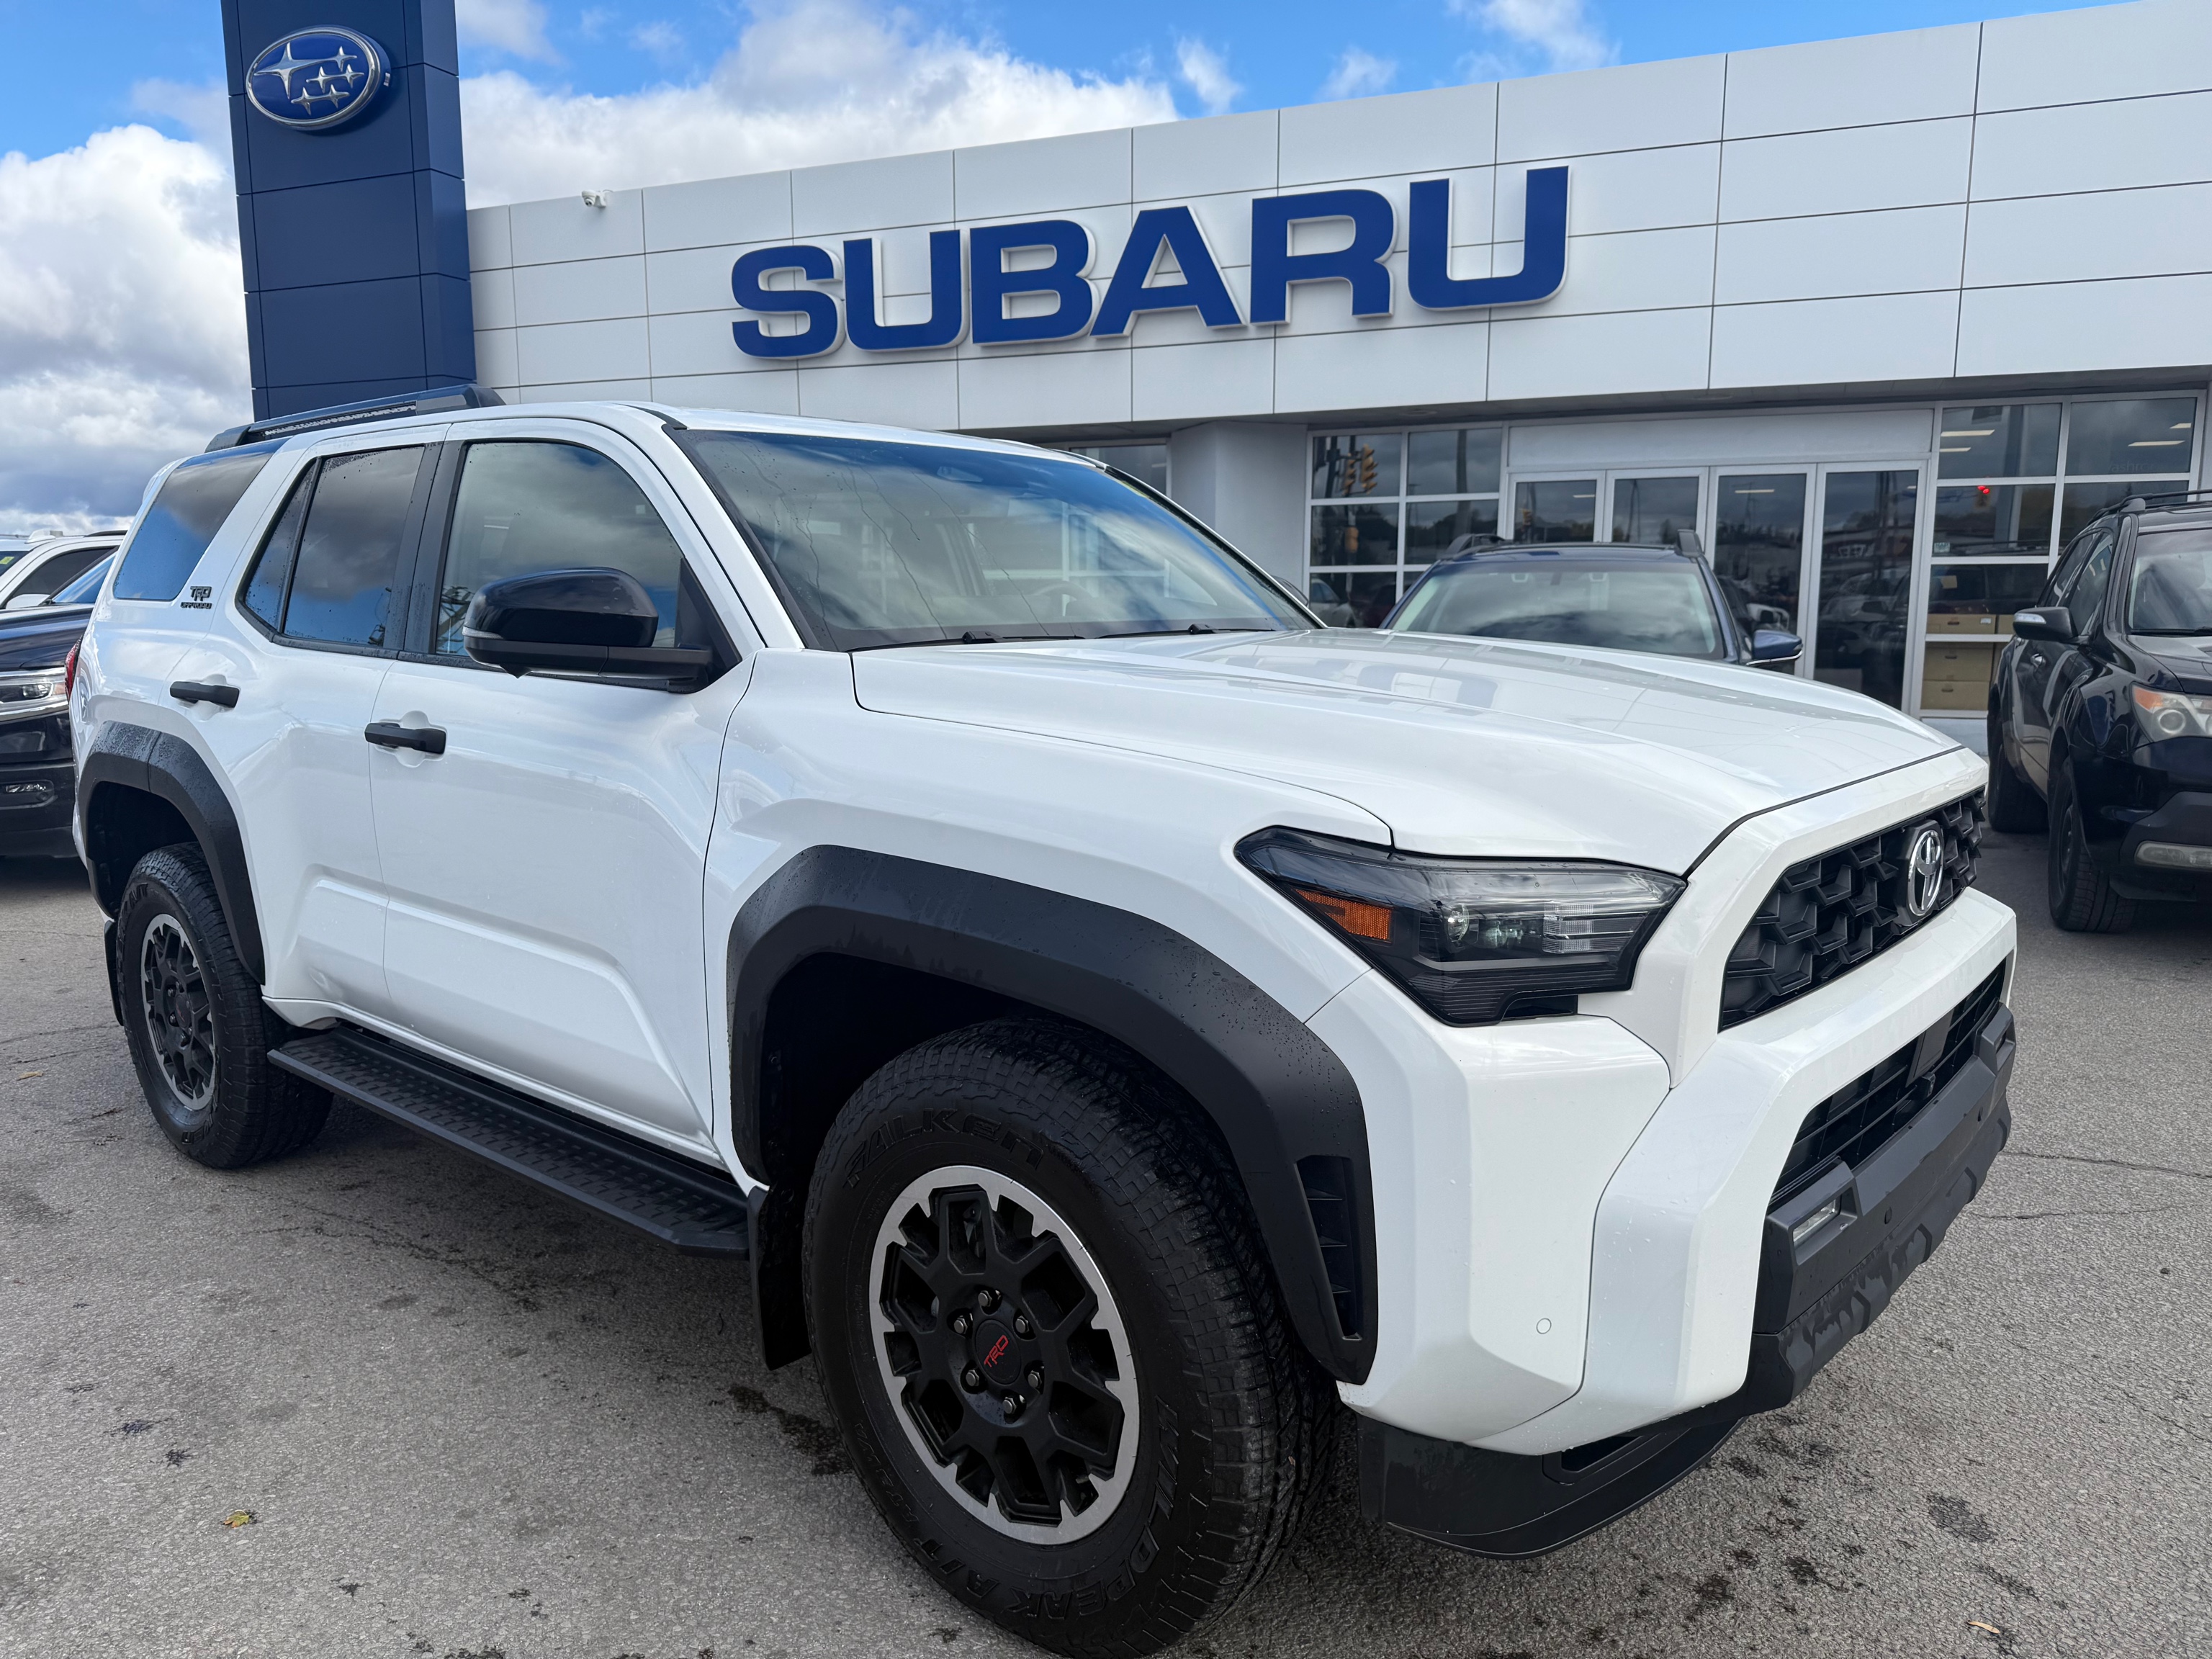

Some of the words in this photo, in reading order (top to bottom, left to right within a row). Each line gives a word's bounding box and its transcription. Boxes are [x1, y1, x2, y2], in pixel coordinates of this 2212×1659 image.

[730, 165, 1571, 360] SUBARU
[190, 585, 212, 601] TRD
[842, 1107, 1045, 1188] FALKEN
[984, 1334, 1009, 1368] TRD
